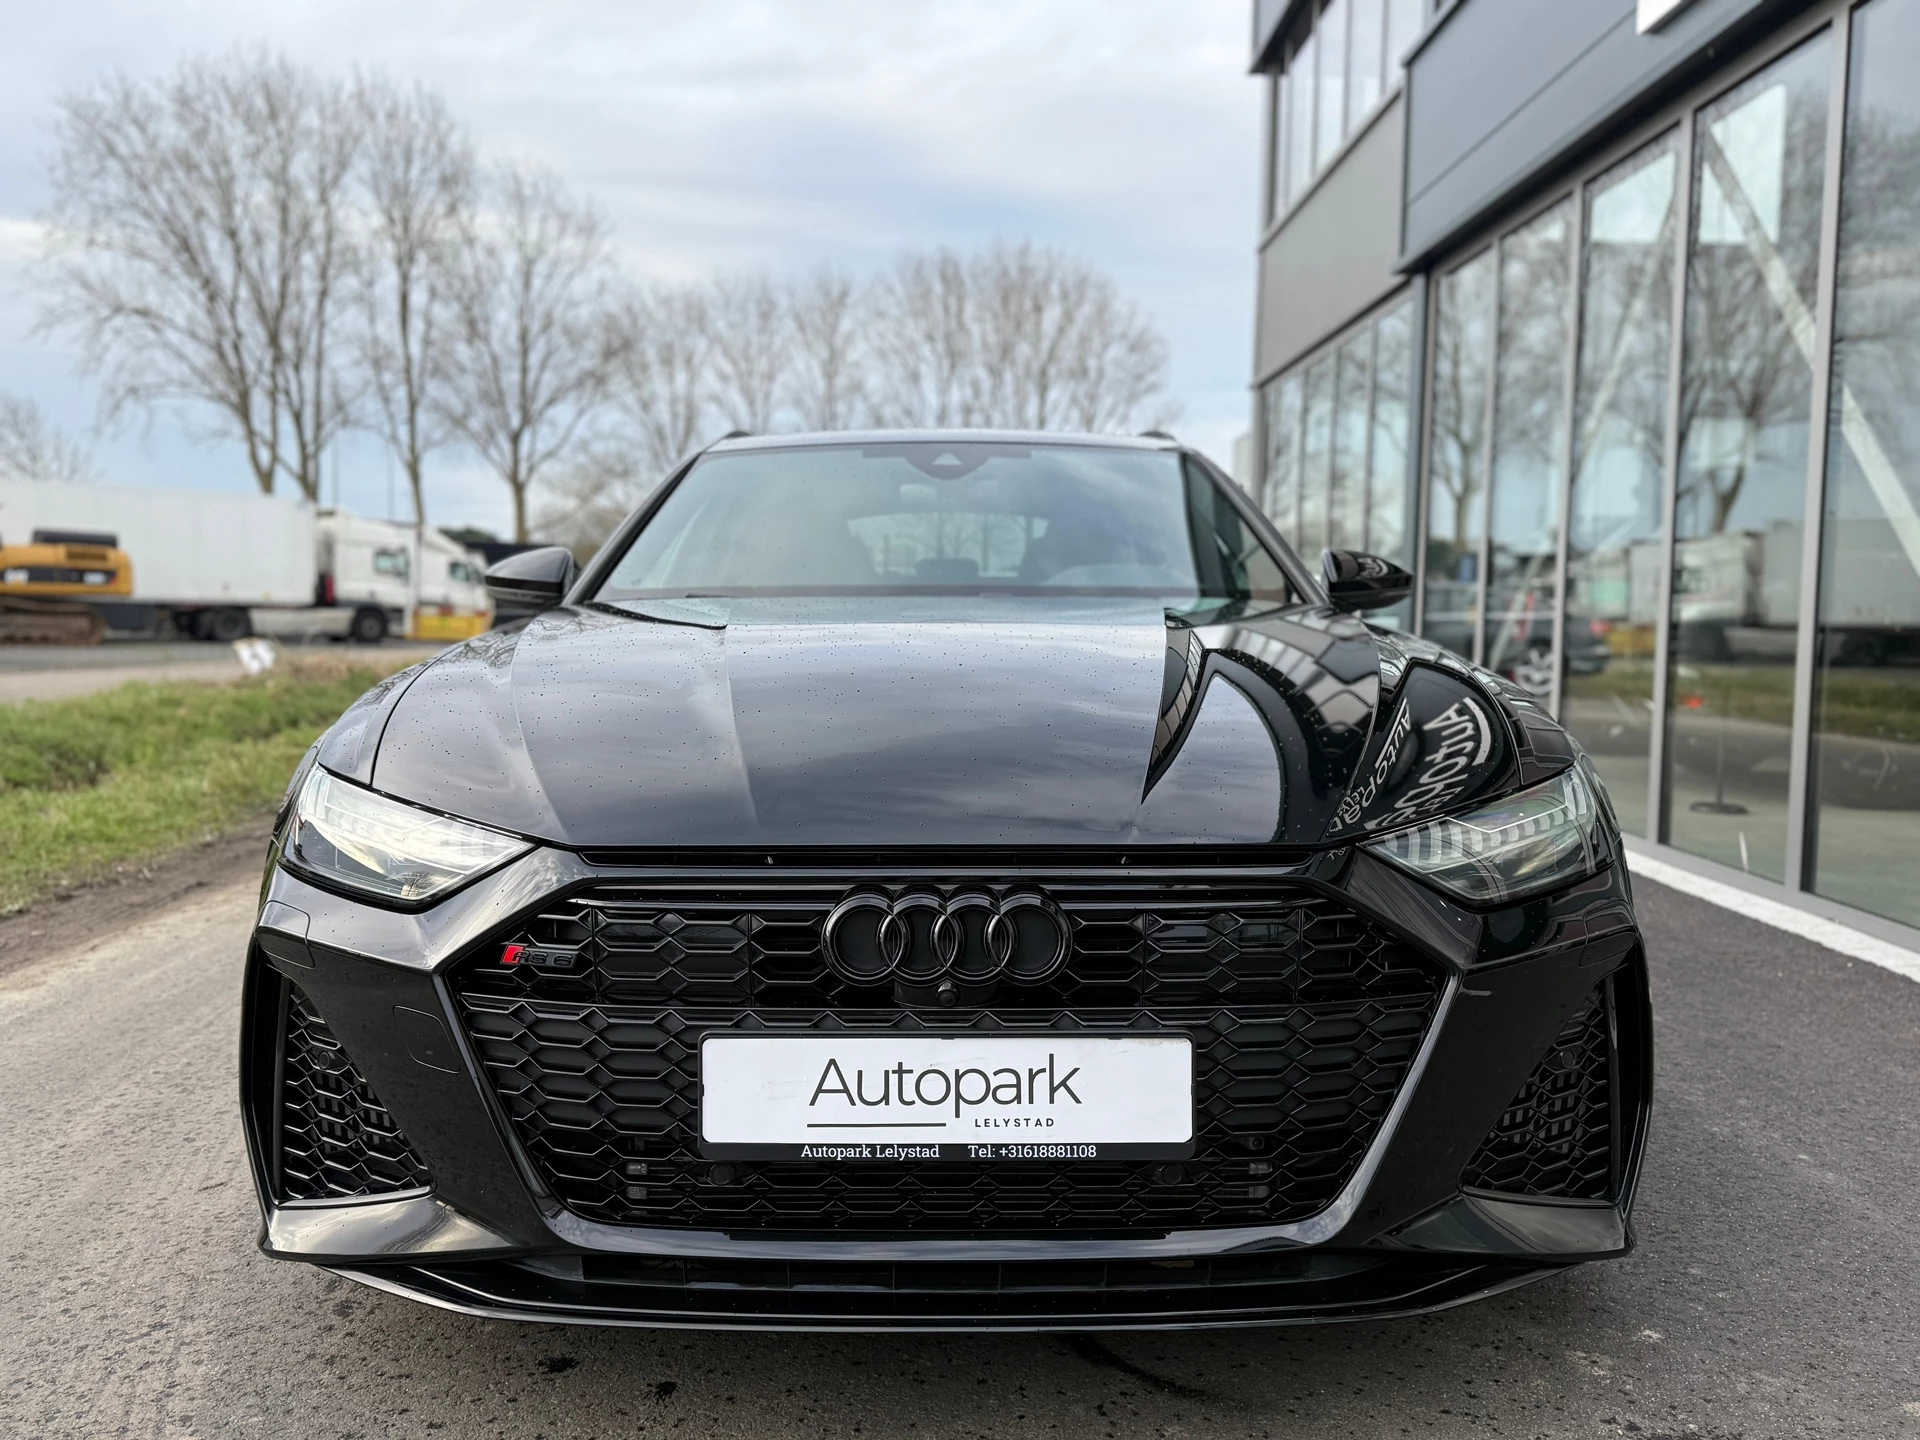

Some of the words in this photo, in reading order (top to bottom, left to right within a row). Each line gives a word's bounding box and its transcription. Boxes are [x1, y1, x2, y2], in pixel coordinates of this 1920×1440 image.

[808, 1053, 1083, 1119] Autopark
[974, 1117, 1055, 1128] LELYSTAD
[800, 1144, 872, 1160] Autopark
[875, 1144, 941, 1161] Lelystad
[967, 1144, 996, 1158] Tel:
[999, 1144, 1097, 1158] +31618881108
